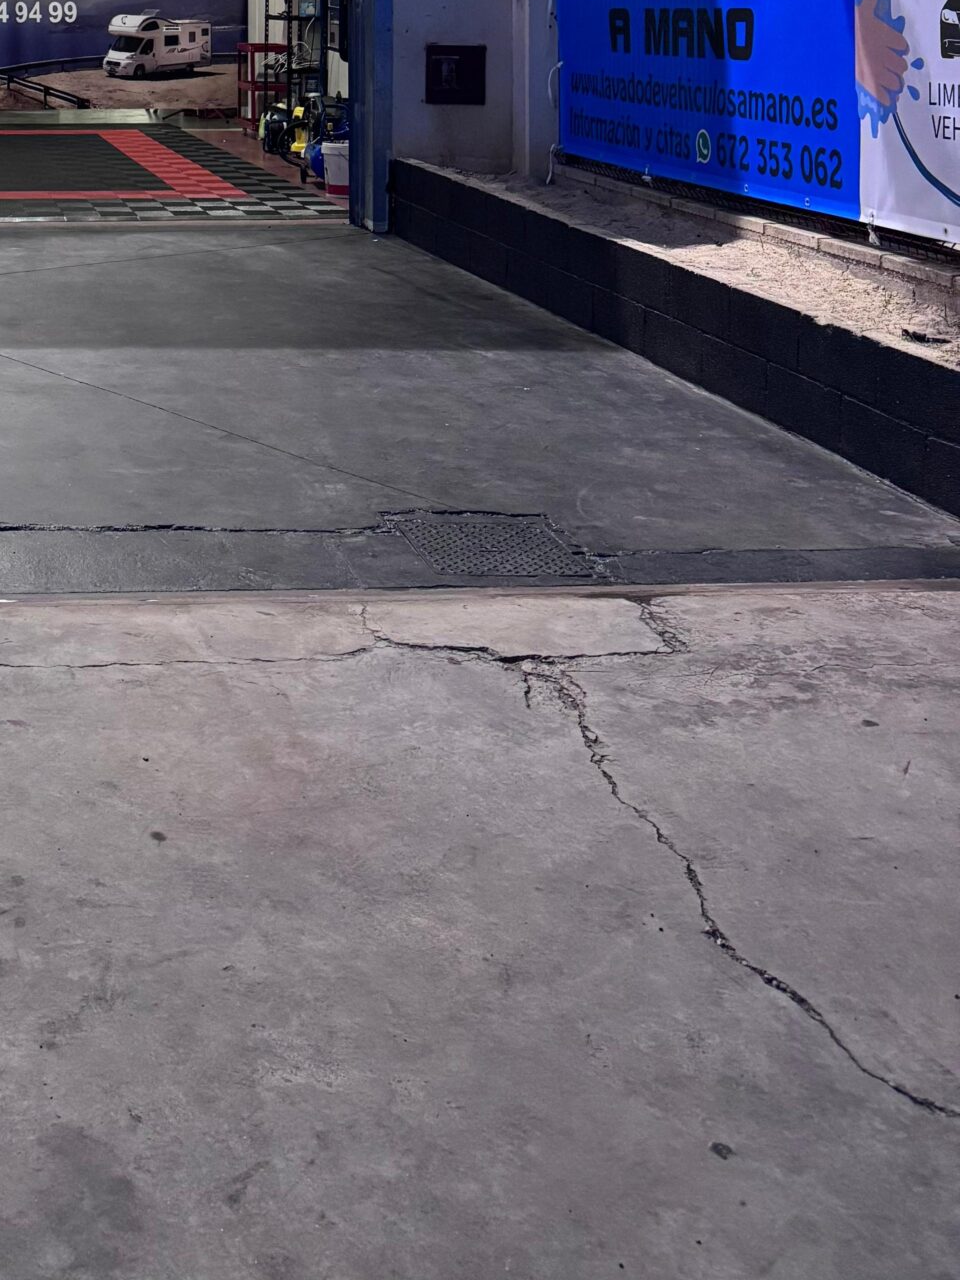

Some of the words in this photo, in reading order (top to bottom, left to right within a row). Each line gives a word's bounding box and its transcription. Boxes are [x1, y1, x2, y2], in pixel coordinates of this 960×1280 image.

[15, 1, 43, 24] 94
[48, 1, 78, 24] 99
[608, 8, 631, 54] A
[644, 7, 754, 61] MANO
[571, 68, 839, 131] www.lavadodevehiculosamano.es
[570, 106, 640, 150] Información
[645, 126, 653, 152] y
[656, 123, 691, 161] citas
[716, 132, 750, 172] 672
[756, 138, 792, 180] 353
[800, 145, 843, 190] 062
